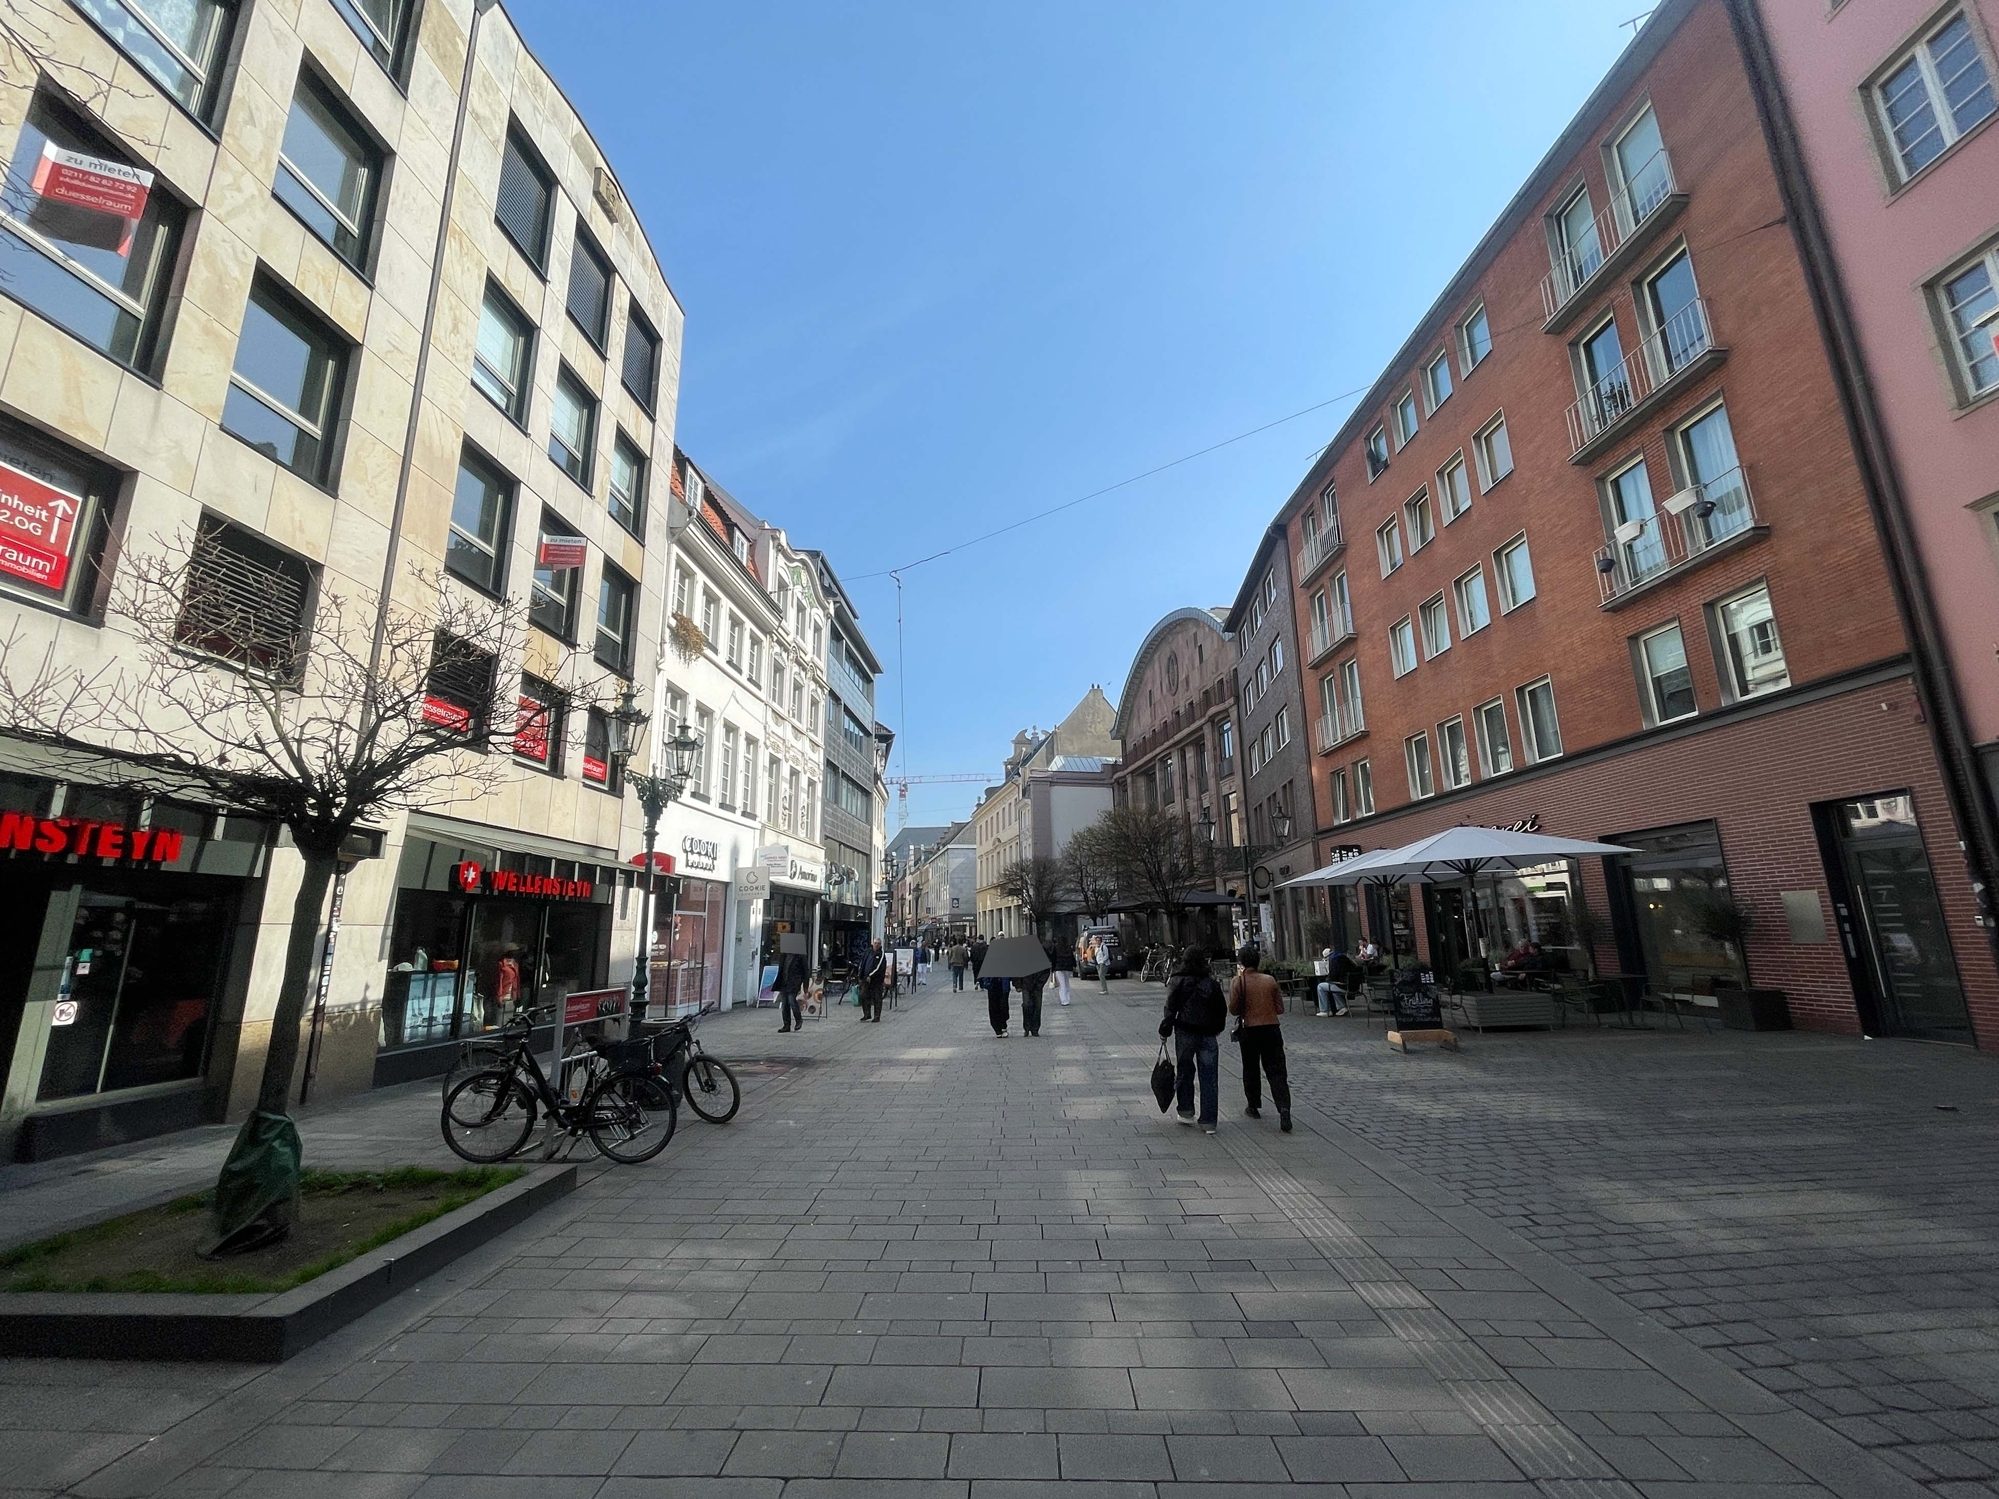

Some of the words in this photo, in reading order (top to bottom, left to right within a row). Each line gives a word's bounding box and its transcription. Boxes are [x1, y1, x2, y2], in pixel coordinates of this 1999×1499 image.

[64, 155, 83, 166] zu
[89, 160, 140, 179] mieten
[55, 186, 132, 211] duesselraum
[490, 870, 593, 898] WELLENSTEYN
[739, 884, 766, 892] COOKIE
